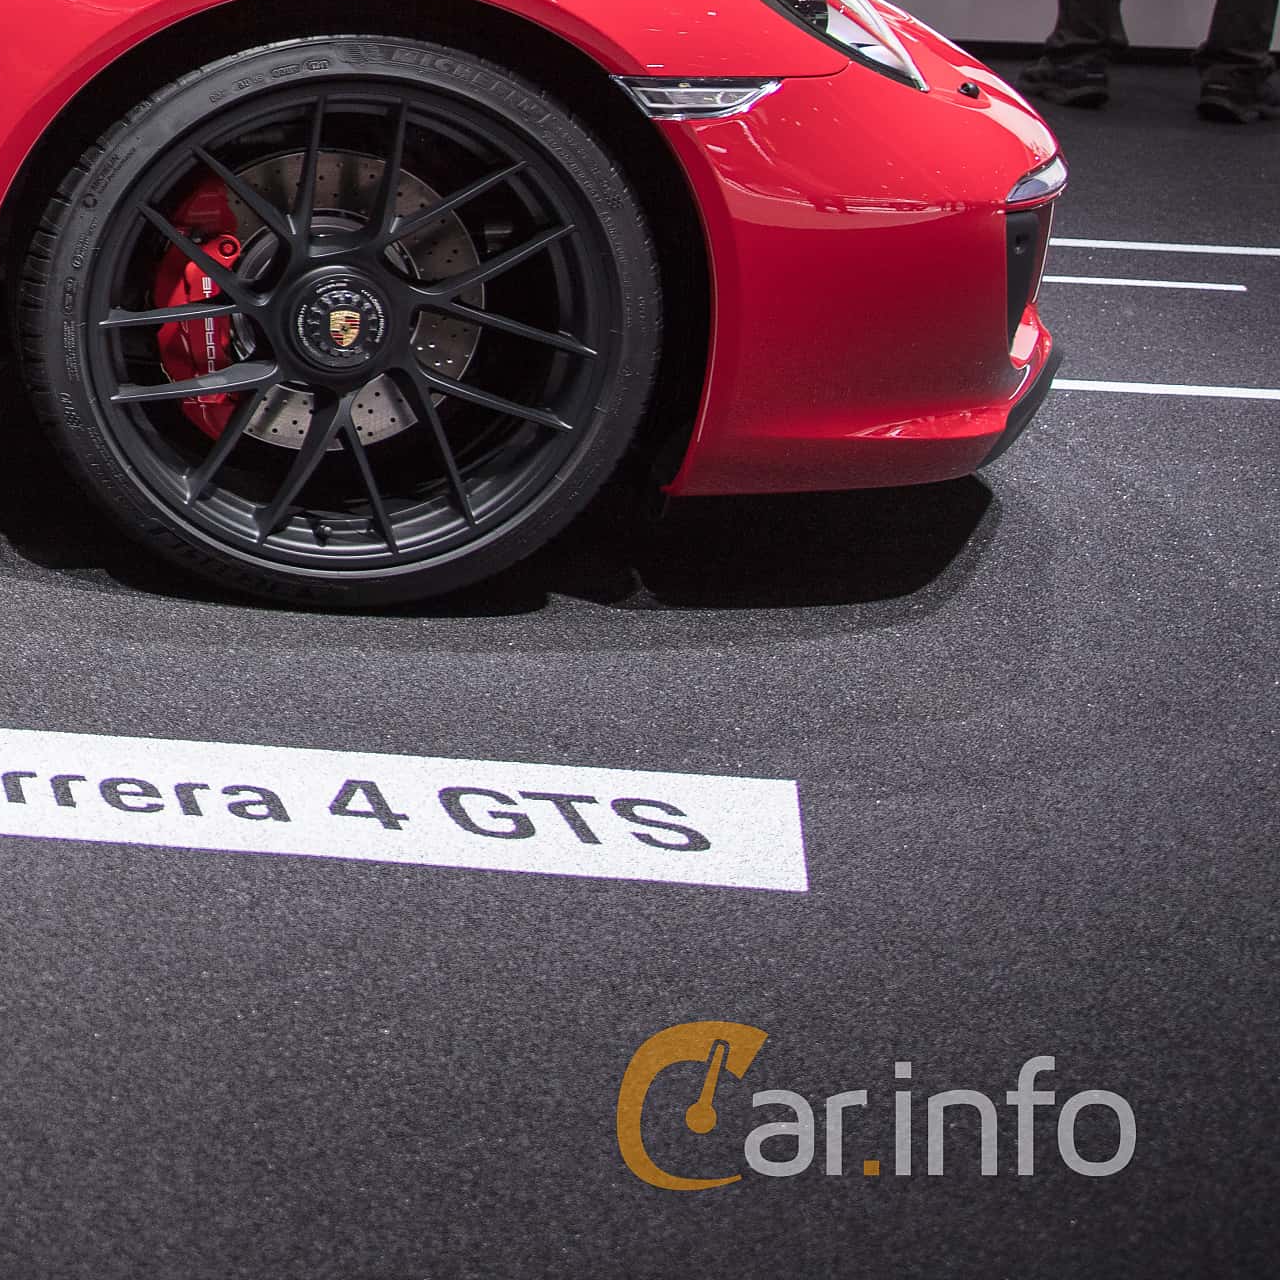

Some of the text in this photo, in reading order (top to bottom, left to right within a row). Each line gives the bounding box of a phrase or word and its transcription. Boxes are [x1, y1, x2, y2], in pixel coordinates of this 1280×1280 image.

[201, 277, 216, 374] PORSHE
[328, 779, 410, 832] 4
[439, 786, 712, 853] GTS
